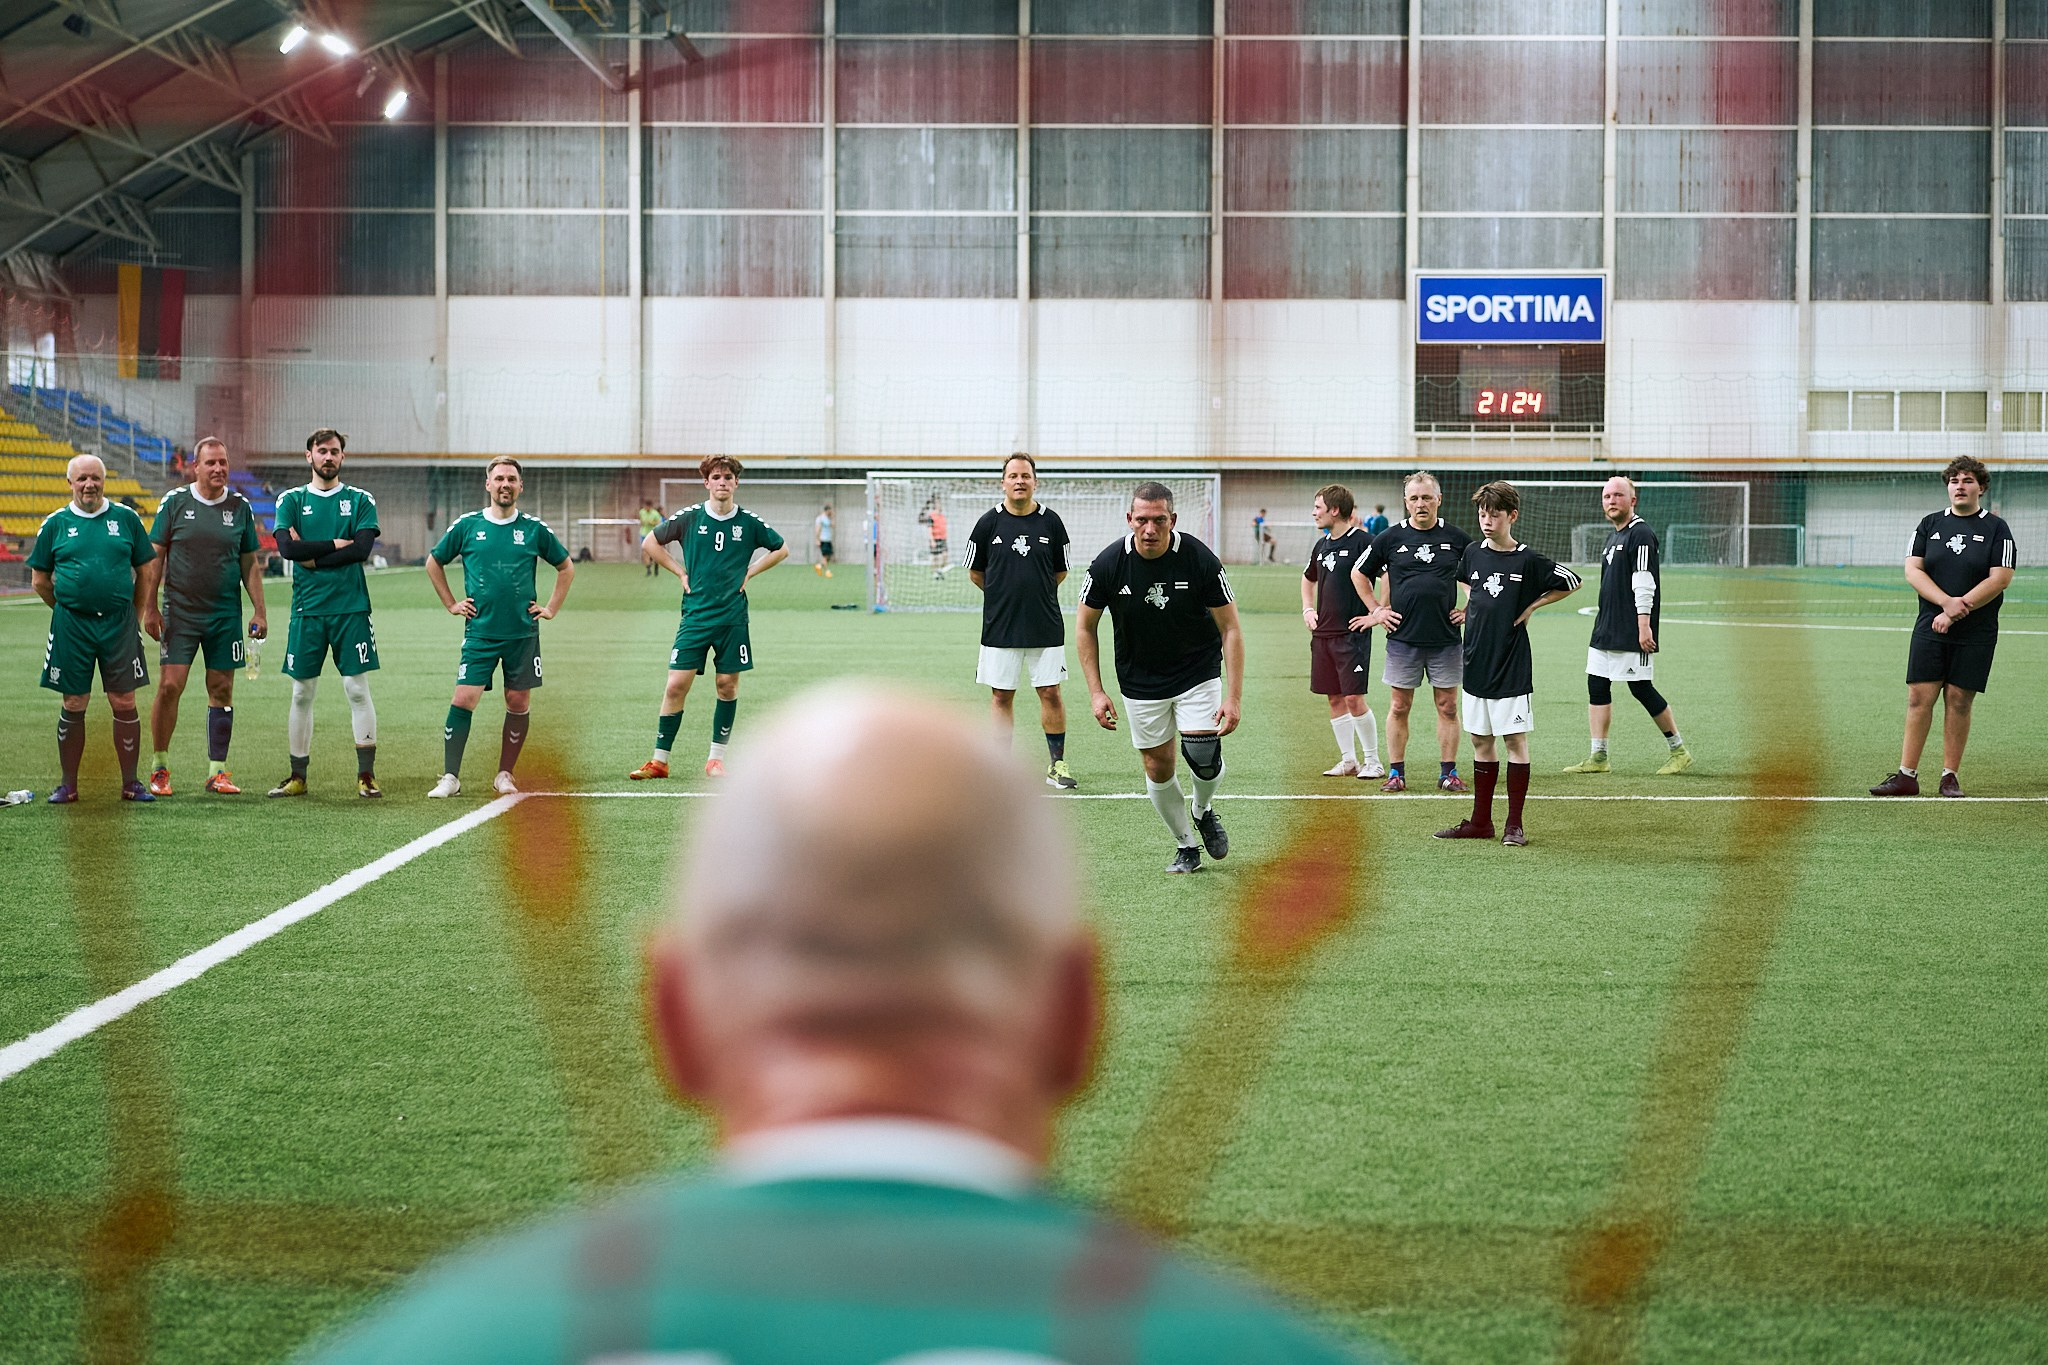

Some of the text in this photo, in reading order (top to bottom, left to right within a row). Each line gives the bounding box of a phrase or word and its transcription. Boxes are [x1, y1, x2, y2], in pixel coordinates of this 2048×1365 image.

[1426, 294, 1595, 323] SPORTIMA
[714, 531, 725, 552] 9
[355, 641, 370, 664] 12
[739, 644, 749, 665] 9
[132, 656, 144, 680] 13
[533, 656, 543, 678] 8
